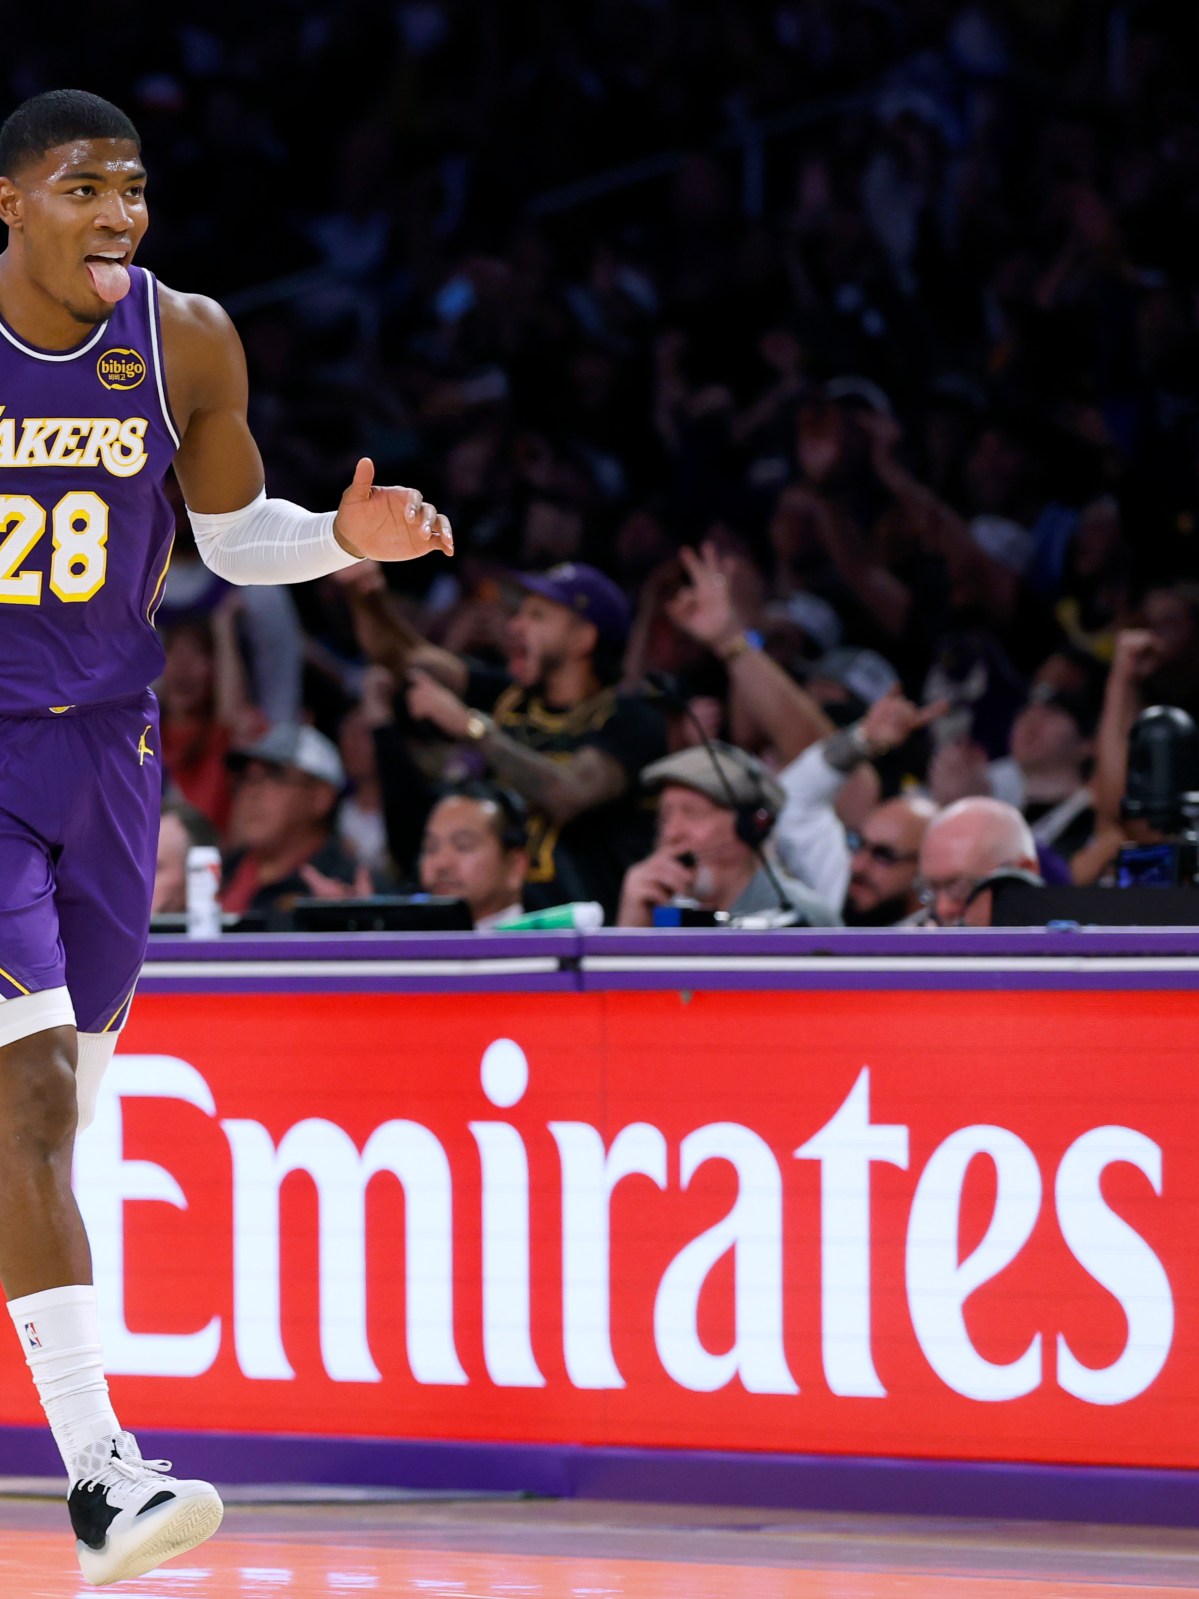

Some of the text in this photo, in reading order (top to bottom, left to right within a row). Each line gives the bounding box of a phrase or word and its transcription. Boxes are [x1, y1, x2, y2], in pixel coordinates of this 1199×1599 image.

[101, 359, 143, 378] bibigo
[108, 373, 126, 381] 비비고
[73, 1038, 1175, 1406] Emirates
